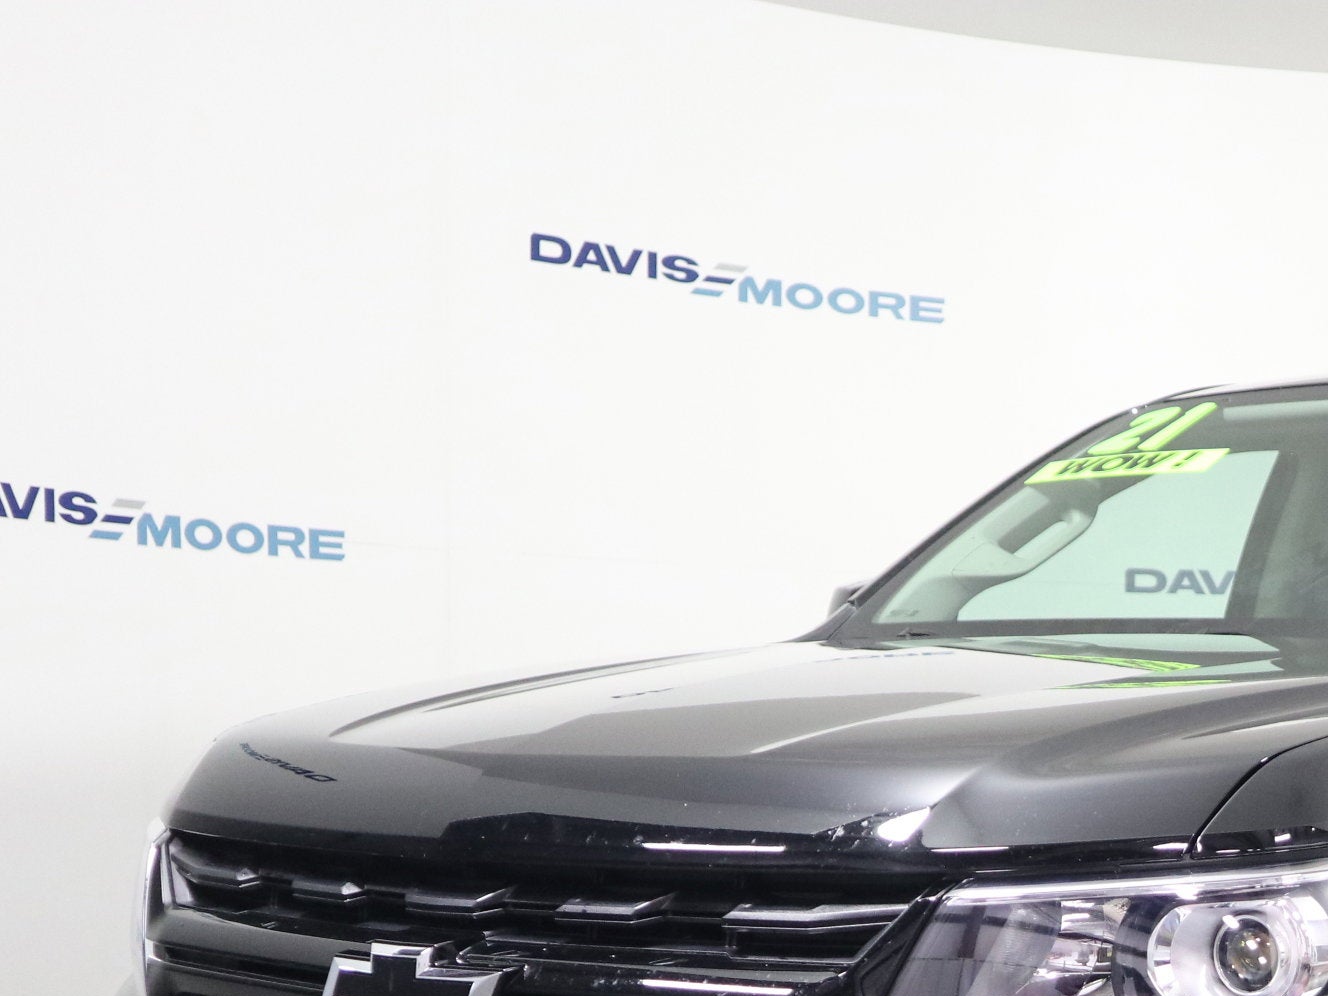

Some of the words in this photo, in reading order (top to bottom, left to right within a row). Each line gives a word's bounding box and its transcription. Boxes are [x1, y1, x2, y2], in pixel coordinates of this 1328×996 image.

[530, 232, 699, 283] DAVIS
[737, 275, 945, 324] MOORE
[1087, 401, 1217, 455] 21
[137, 513, 346, 561] MOORE
